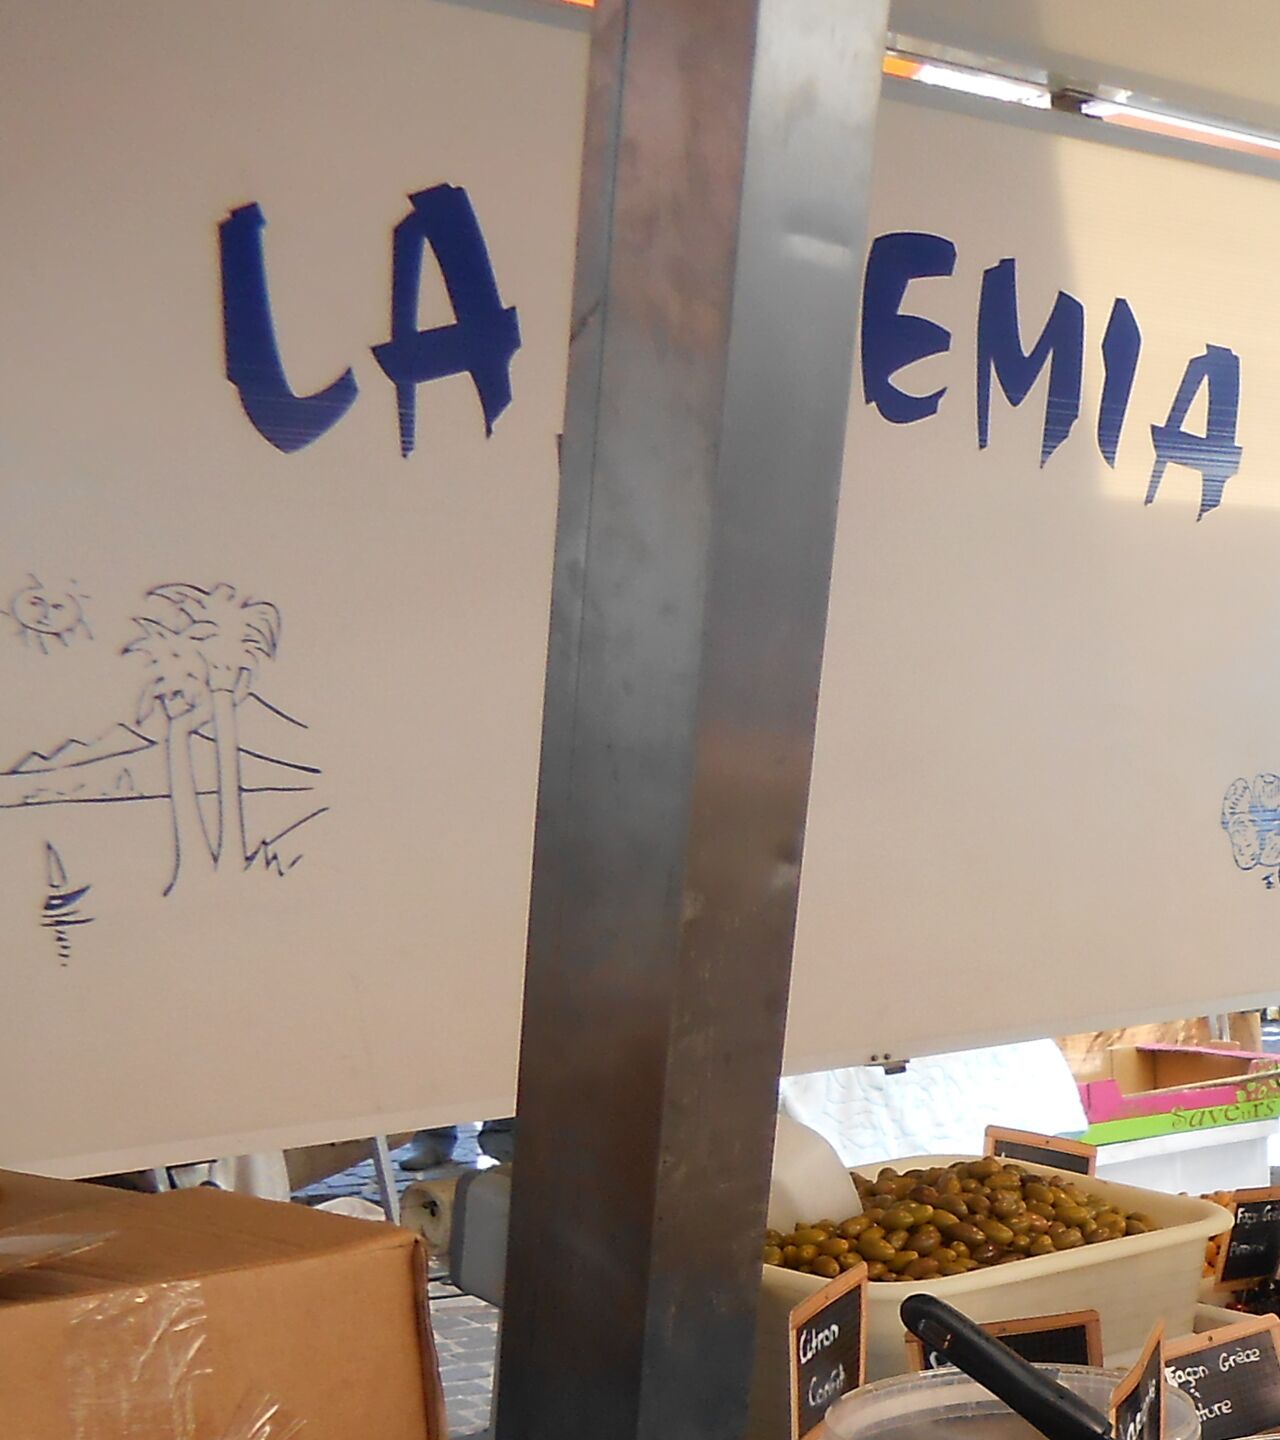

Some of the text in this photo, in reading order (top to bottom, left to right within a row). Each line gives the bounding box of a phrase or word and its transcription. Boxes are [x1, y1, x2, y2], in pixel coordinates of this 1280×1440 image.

[218, 182, 1244, 524] LA EMIA
[800, 1323, 839, 1364] Citron
[1164, 1364, 1209, 1388] Façon
[1196, 1399, 1232, 1421] ture
